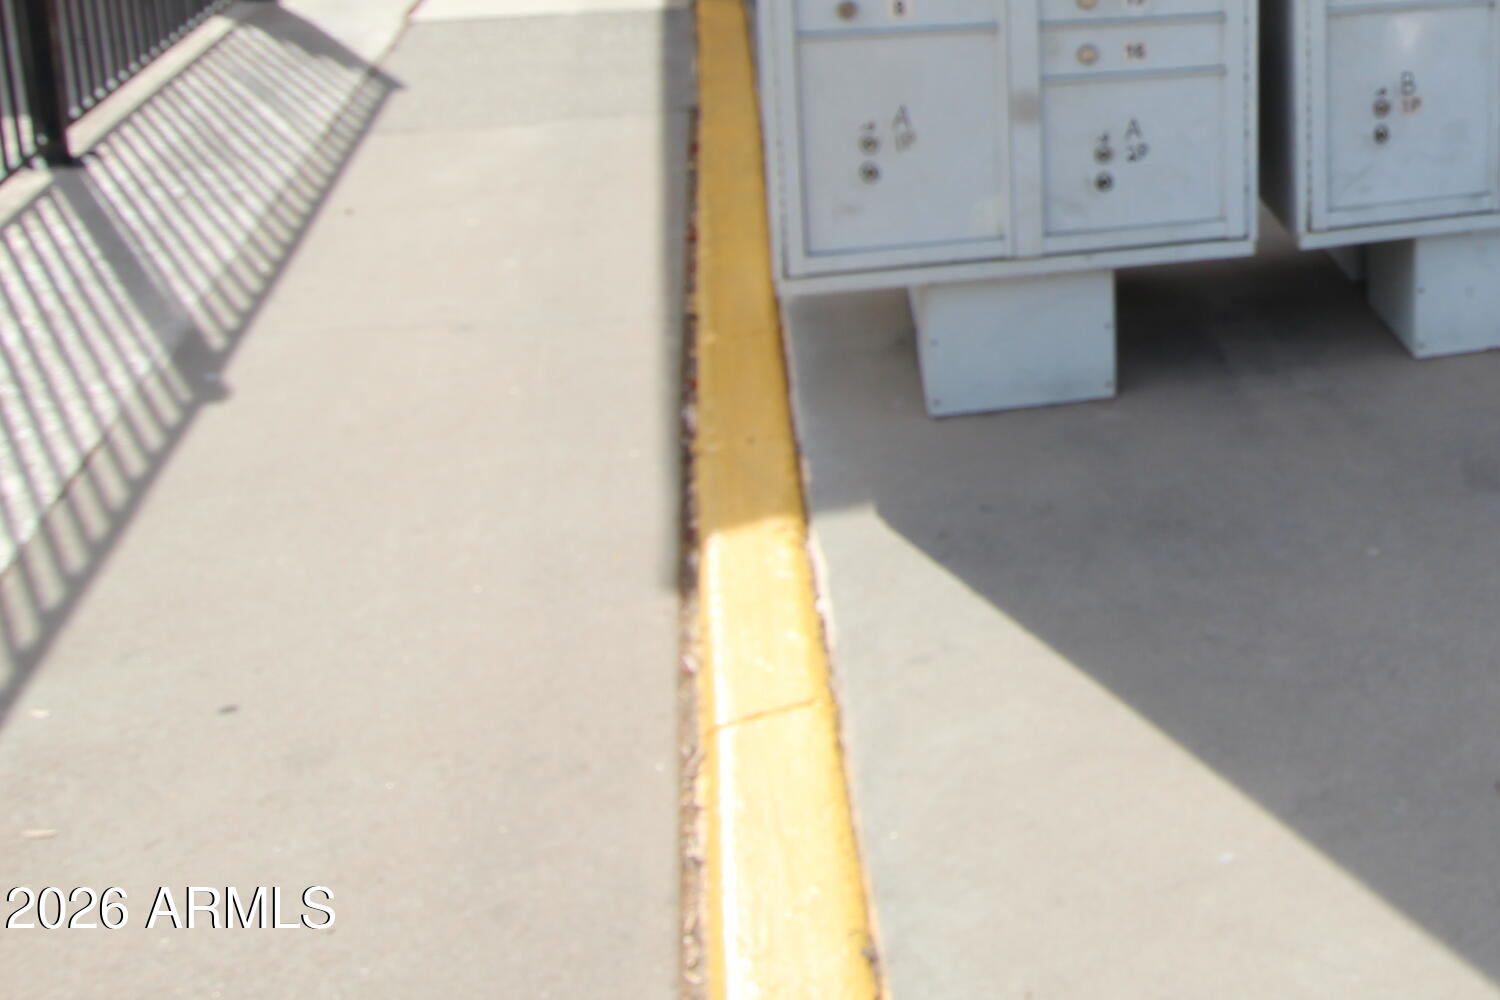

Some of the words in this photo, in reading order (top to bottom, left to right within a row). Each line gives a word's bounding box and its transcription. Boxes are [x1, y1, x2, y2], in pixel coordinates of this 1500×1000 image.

[1125, 43, 1146, 60] 16
[1400, 70, 1417, 96] B
[891, 104, 912, 131] A
[1124, 116, 1143, 140] A
